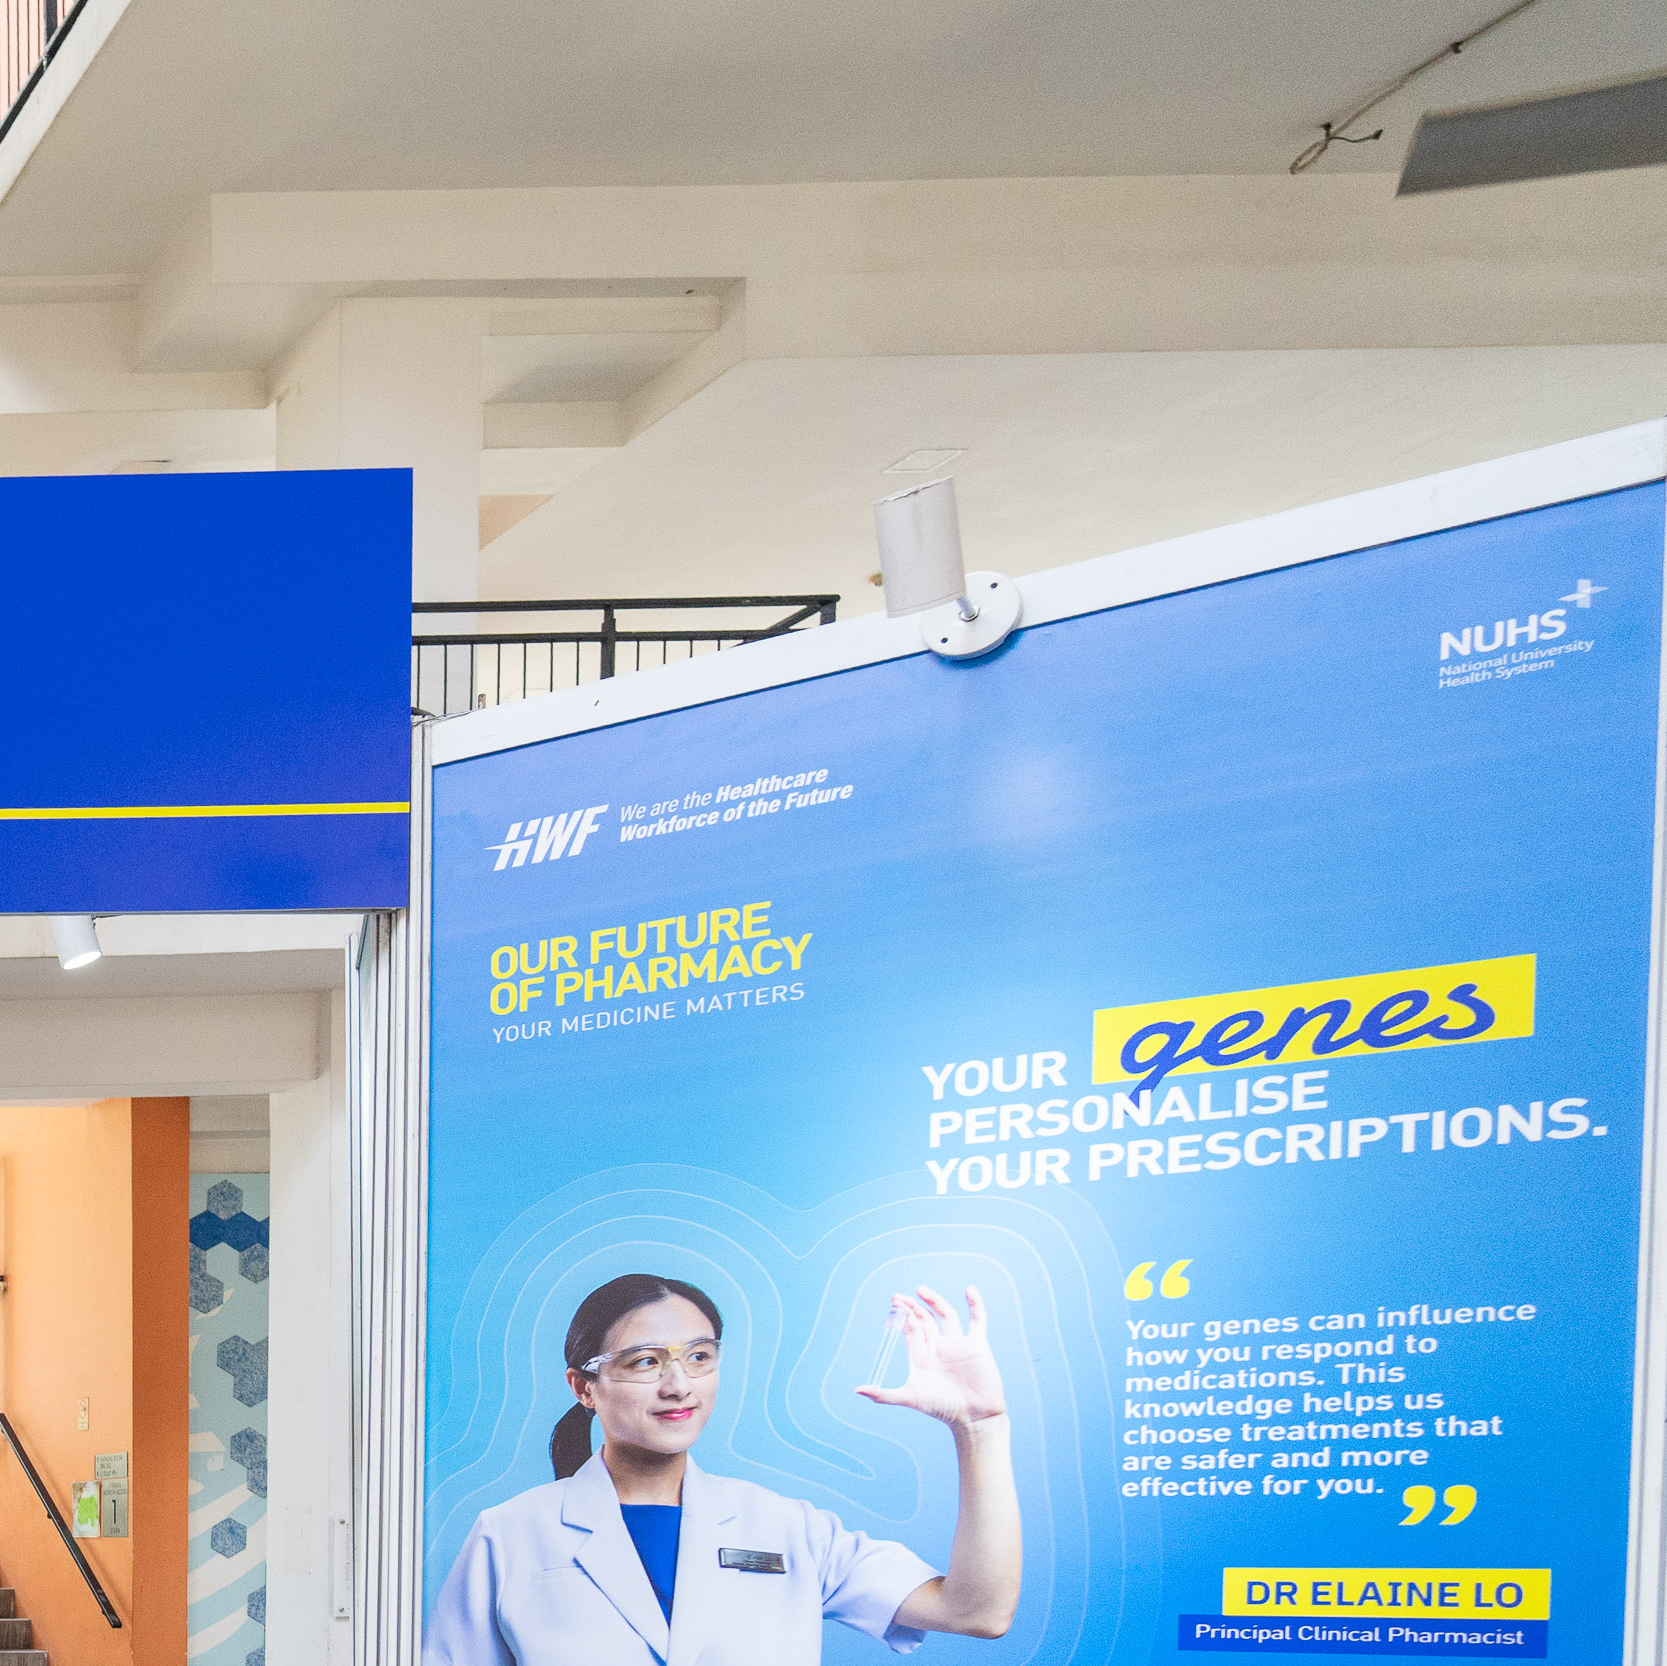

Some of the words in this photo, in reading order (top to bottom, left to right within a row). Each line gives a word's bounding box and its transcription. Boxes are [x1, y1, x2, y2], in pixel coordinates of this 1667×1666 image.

[1439, 608, 1567, 661] NUHS
[1439, 655, 1507, 678] National
[1511, 639, 1595, 663] University
[1438, 671, 1492, 690] Health
[1495, 659, 1555, 680] System
[484, 804, 609, 871] HWF
[620, 810, 719, 843] Workforce
[723, 802, 744, 820] of
[747, 795, 779, 816] the
[784, 783, 853, 810] Future
[490, 935, 578, 980] OUR
[590, 901, 772, 965] FUTURE
[490, 977, 545, 1015] OF
[556, 933, 814, 1006] PHARMACY
[922, 1051, 1067, 1100] YOUR
[1120, 983, 1495, 1113] genes
[928, 1070, 1329, 1149] PERSONALISE
[925, 1147, 1071, 1195] YOUR
[1088, 1097, 1609, 1181] PRESCRIPTIONS.
[1126, 1319, 1194, 1340] Your
[1203, 1316, 1299, 1341] genes
[1309, 1312, 1366, 1331] can
[1376, 1303, 1537, 1328] influence
[1246, 1581, 1299, 1605] DR
[1311, 1581, 1460, 1608] ELAINE
[1473, 1583, 1523, 1609] LO
[1195, 1623, 1291, 1644] Principal
[1297, 1625, 1381, 1642] Clinical
[1387, 1627, 1524, 1645] Pharmacist
